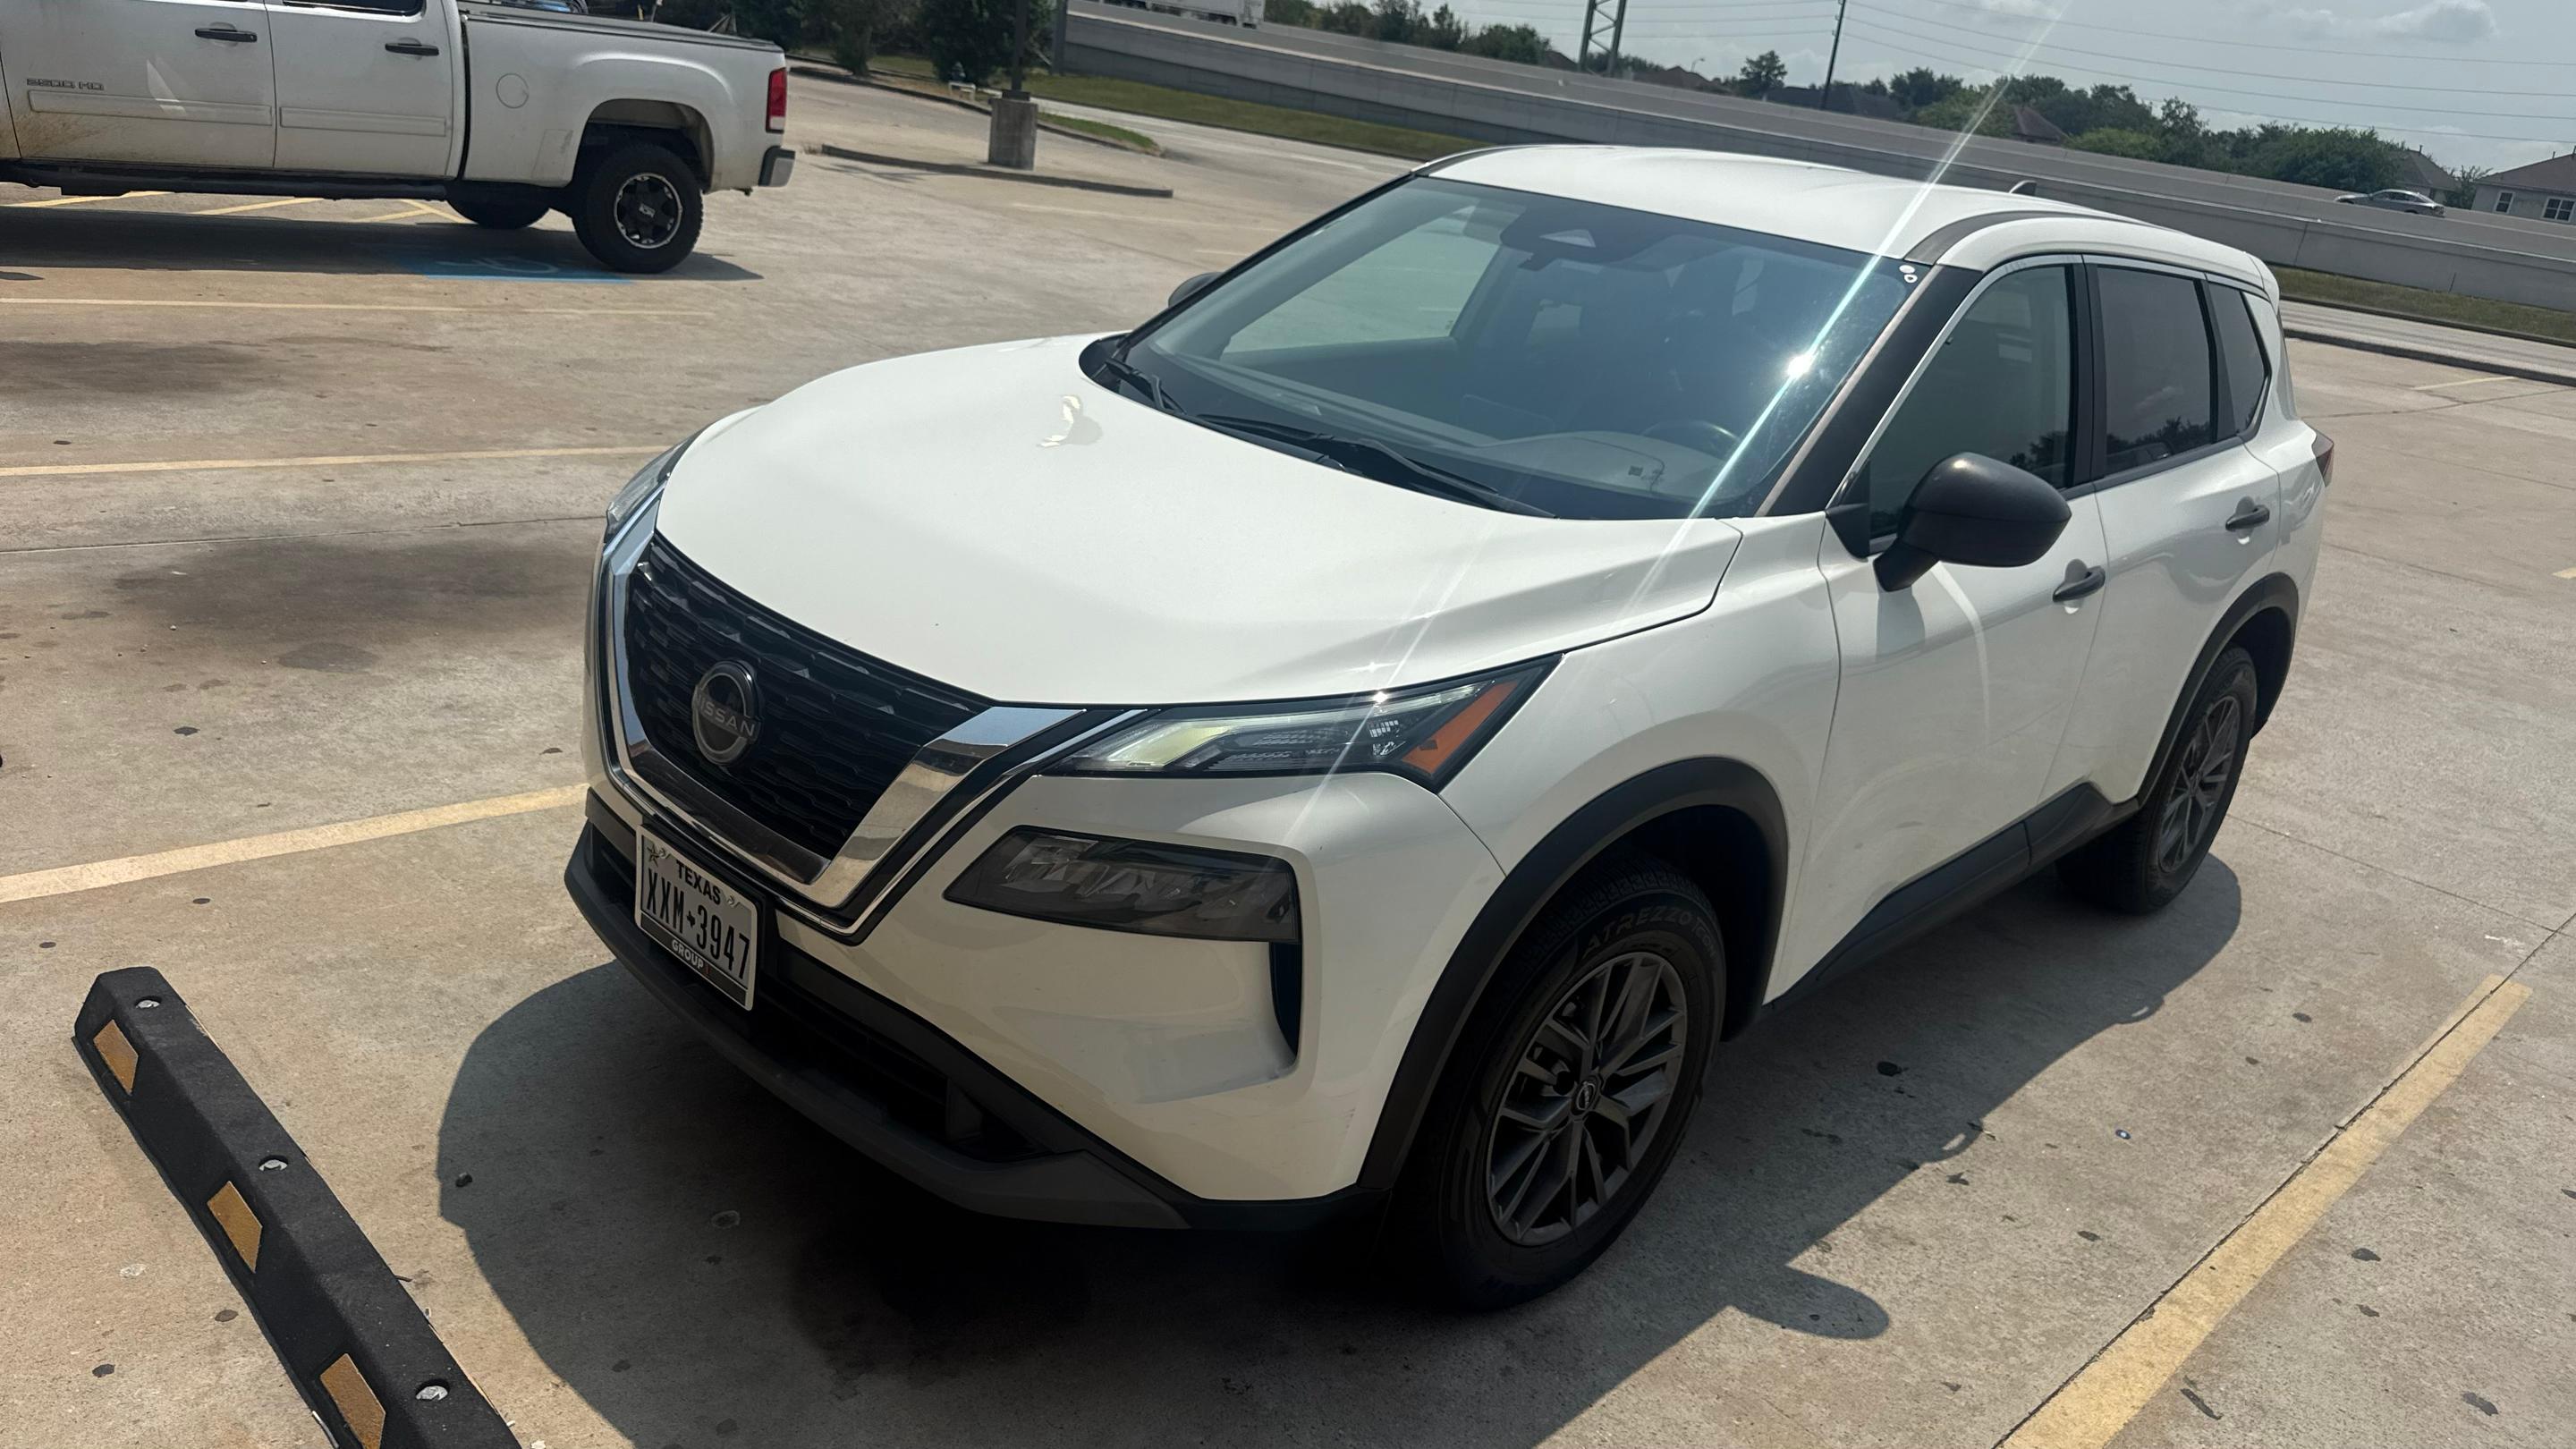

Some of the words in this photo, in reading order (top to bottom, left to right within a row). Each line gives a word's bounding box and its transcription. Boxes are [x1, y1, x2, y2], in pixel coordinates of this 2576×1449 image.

[79, 81, 104, 90] HD
[697, 693, 756, 737] NISSAN
[676, 860, 721, 905] TEXAS
[1581, 903, 1691, 960] ATREZZO
[672, 938, 704, 970] GROUP
